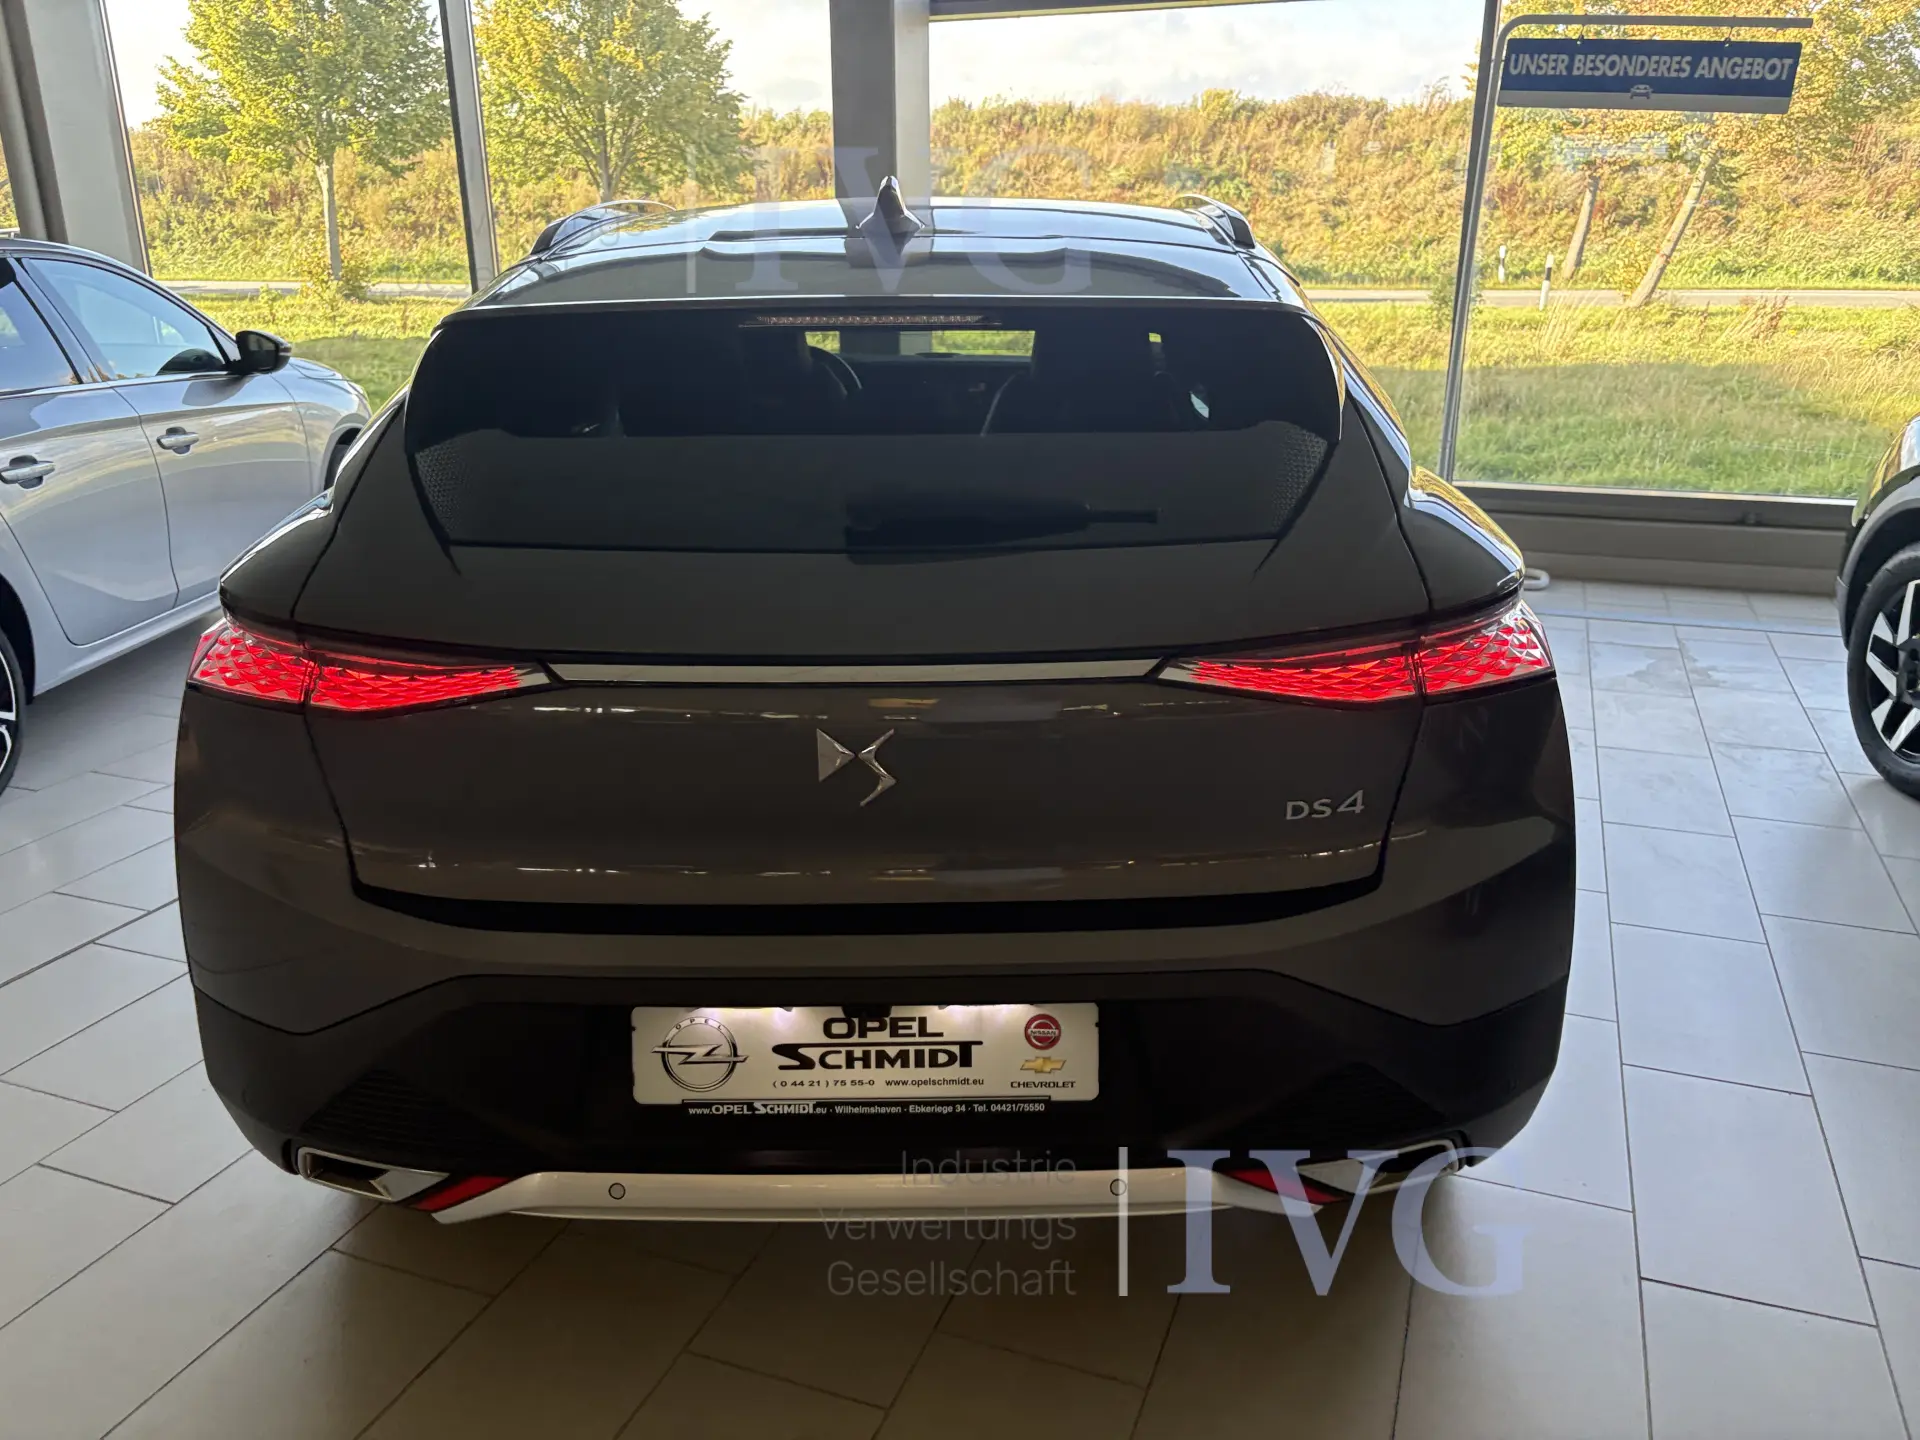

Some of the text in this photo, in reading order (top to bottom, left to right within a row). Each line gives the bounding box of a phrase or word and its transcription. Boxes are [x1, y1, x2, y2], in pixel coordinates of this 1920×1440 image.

[1508, 53, 1794, 81] UNSER BESONDERES ANGEBOT
[823, 1016, 944, 1040] OPEL
[772, 1041, 984, 1071] SCHMIDT
[885, 1077, 985, 1088] www.opelschmidt.eu
[1010, 1080, 1076, 1089] CHEVROLET
[835, 1104, 901, 1114] Wilhelmshaven
[955, 1104, 966, 1113] 34
[973, 1104, 989, 1113] Tel.
[990, 1103, 1045, 1112] 04421/75550
